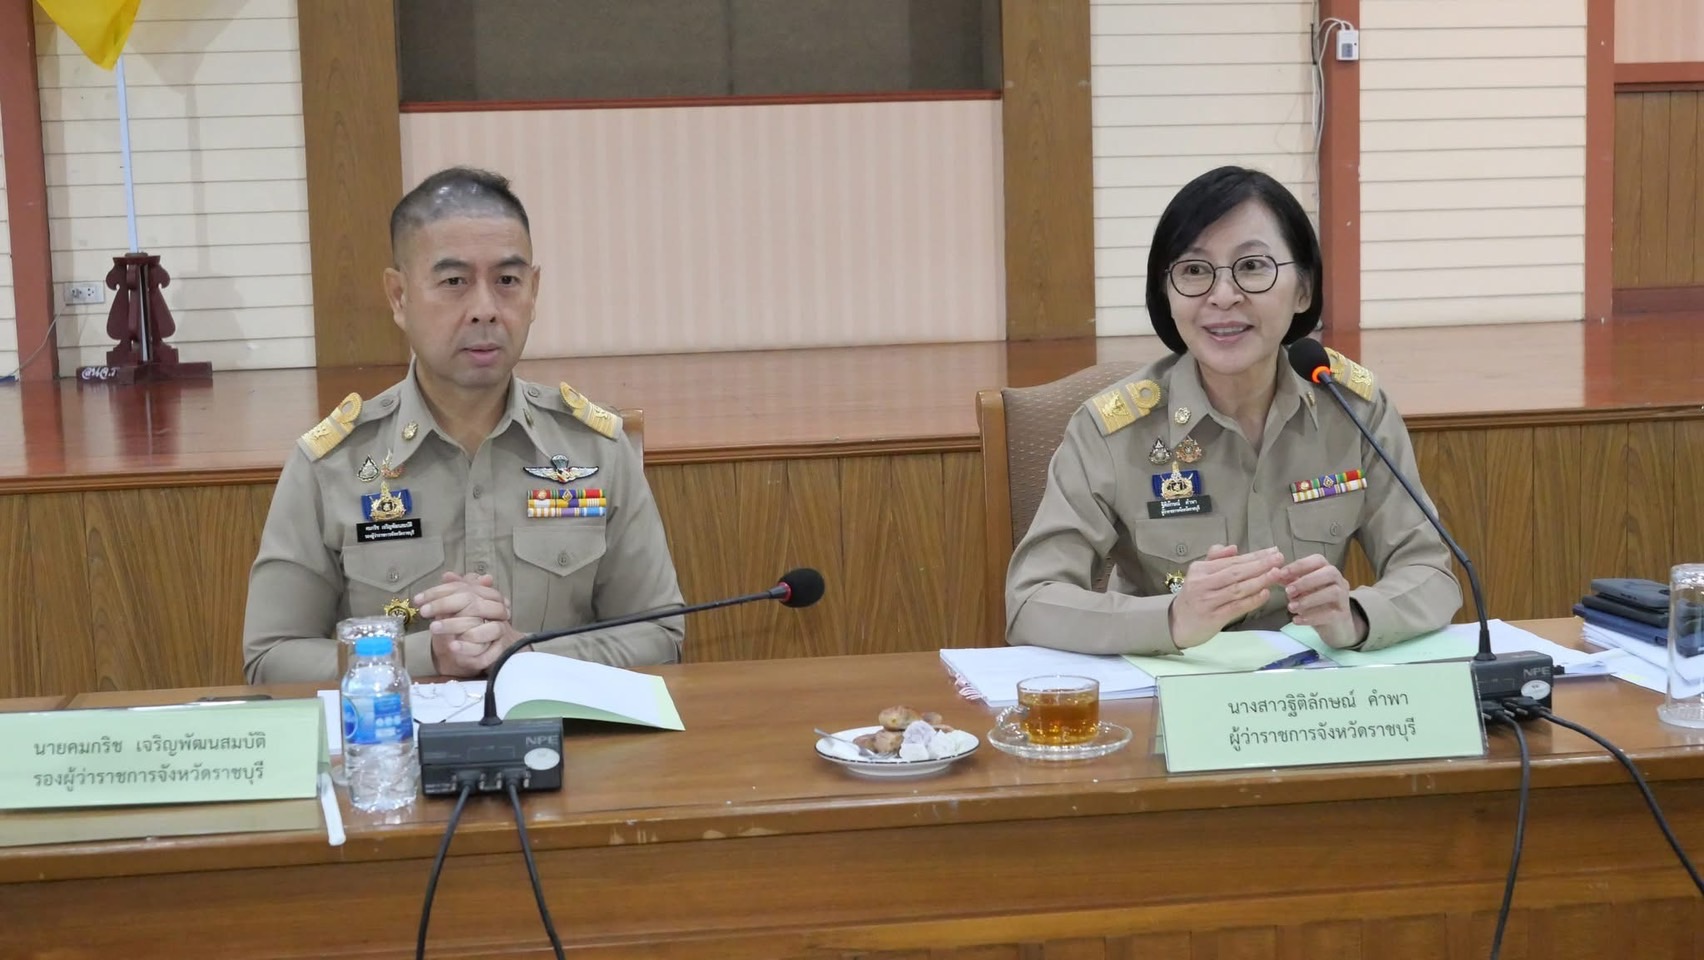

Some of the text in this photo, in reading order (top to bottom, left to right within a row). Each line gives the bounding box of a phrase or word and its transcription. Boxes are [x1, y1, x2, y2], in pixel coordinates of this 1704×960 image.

[1523, 666, 1551, 678] NPE
[1228, 689, 1409, 717] นางสาวฐิติลักษณ์ คำพา
[34, 731, 267, 757] นายคมกริช เจริญพัฒนสมบัติ
[525, 734, 558, 746] NPE
[1229, 717, 1416, 752] ผู้ว่าราชการจังหวัดราชบุรี
[33, 760, 265, 792] รองผู้ว่าราชการจังหวัดราชบุรี
